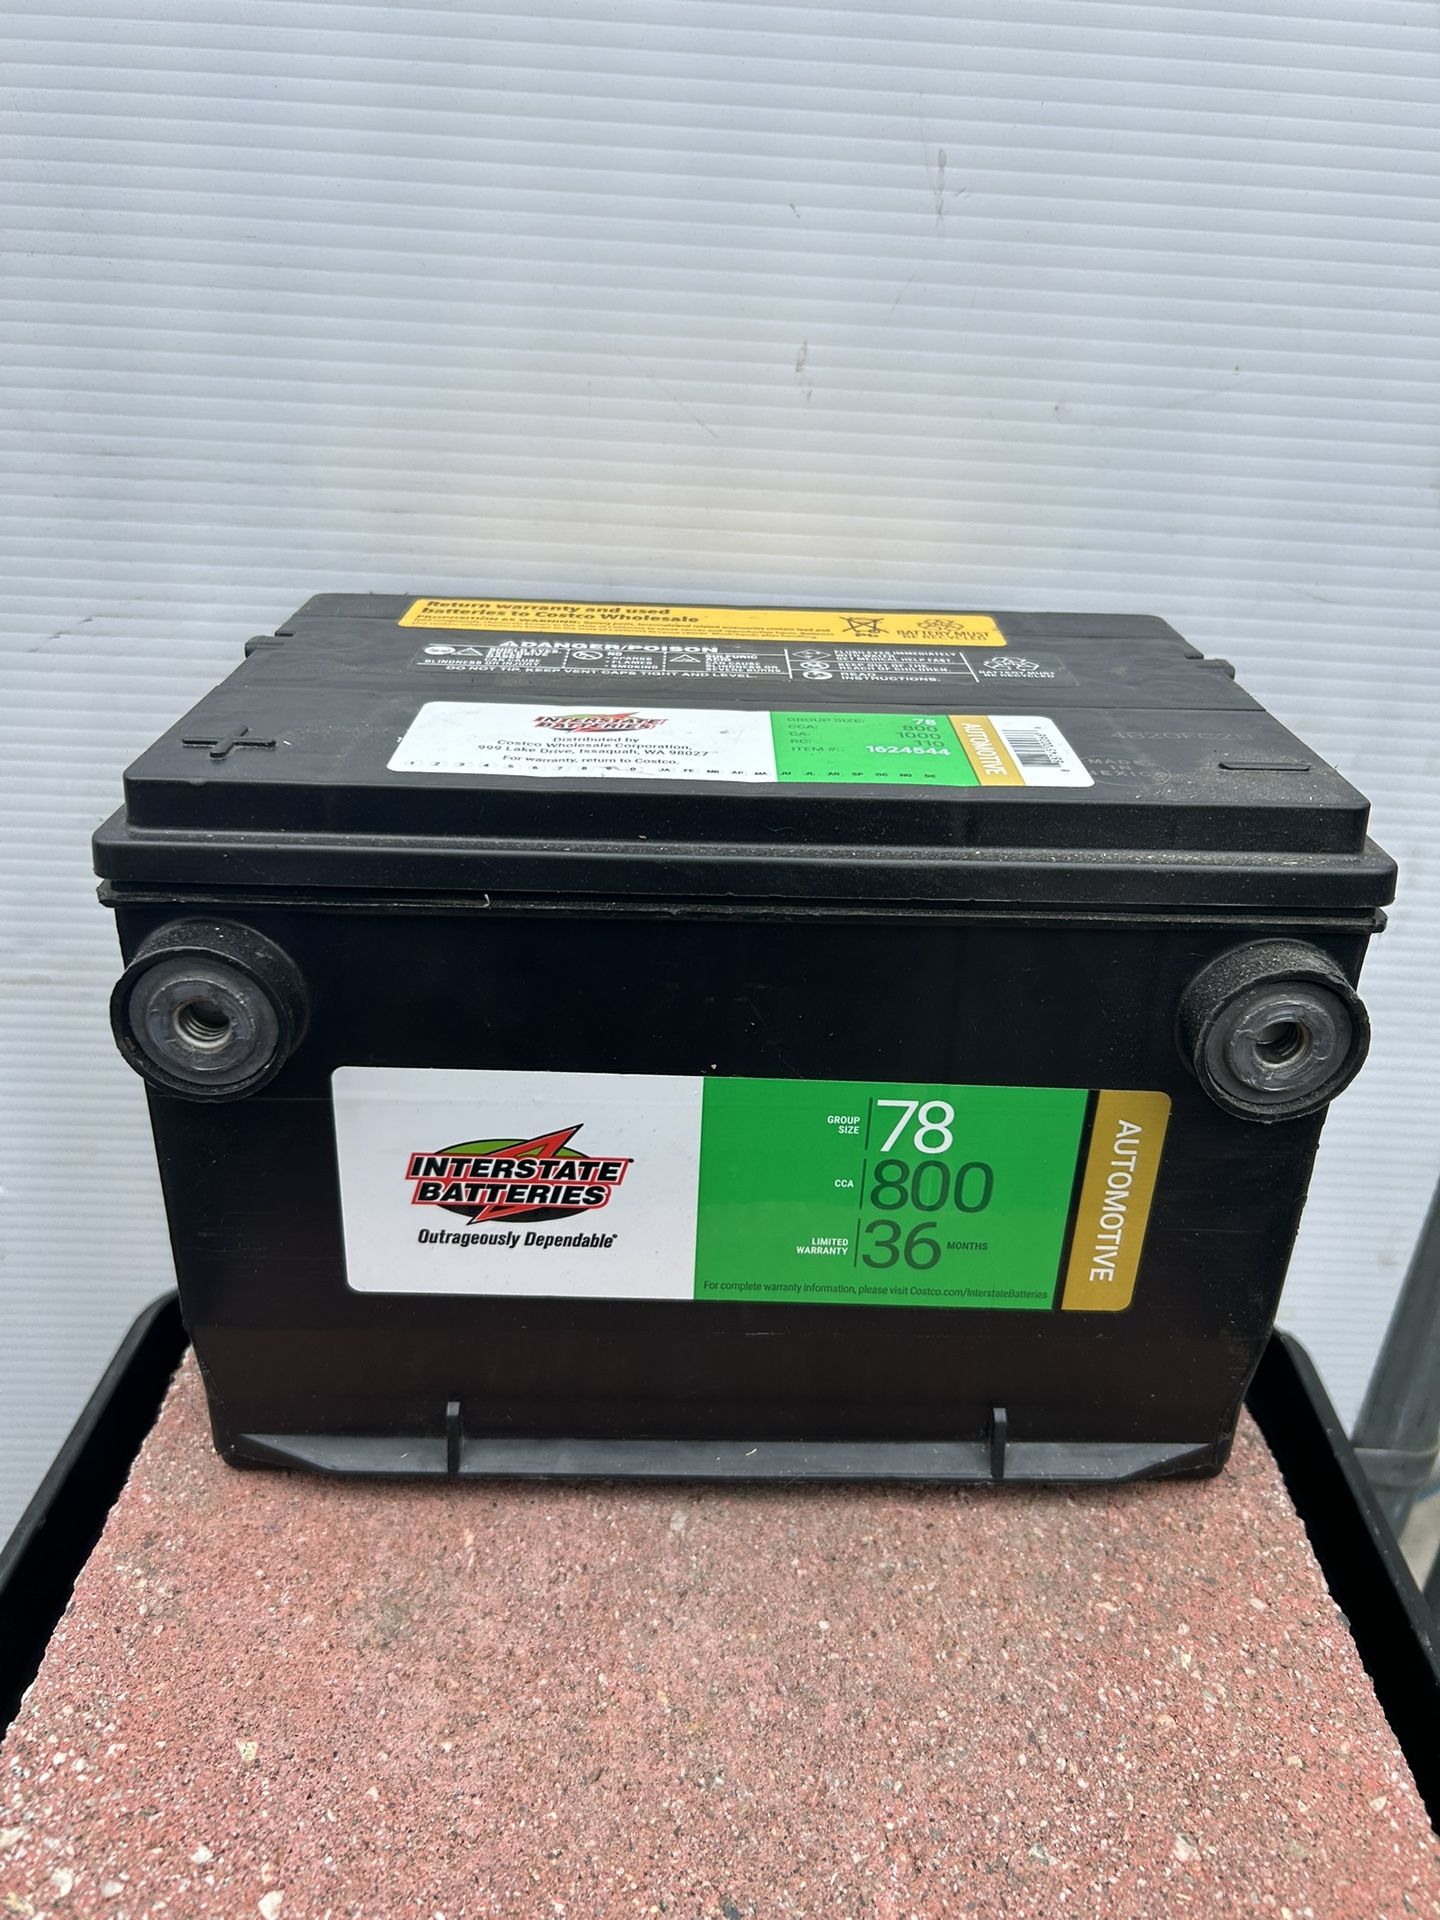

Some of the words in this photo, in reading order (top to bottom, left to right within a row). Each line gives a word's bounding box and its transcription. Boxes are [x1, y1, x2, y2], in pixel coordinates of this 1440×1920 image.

[496, 604, 580, 612] warranty
[421, 607, 506, 616] batteries
[535, 611, 595, 620] Costco
[600, 613, 699, 622] Wholesale
[520, 641, 719, 653] DANGER/POISON
[912, 718, 936, 726] 78
[896, 732, 942, 740] 1000
[497, 739, 542, 747] Costco
[615, 743, 692, 751] Corporation,
[865, 745, 951, 756] 1624544
[961, 722, 1009, 775] AUTOMOTIVE
[827, 1115, 861, 1125] GROUP
[838, 1125, 860, 1134] SIZE
[877, 1099, 955, 1154] 78
[411, 1156, 622, 1182] INTERSTATE
[834, 1178, 854, 1188] CCA
[870, 1159, 994, 1213] 800
[417, 1182, 606, 1206] BATTERIES
[1089, 1119, 1142, 1281] AUTOMOTIVE
[417, 1228, 520, 1249] Outrageously
[811, 1237, 849, 1247] LIMITED
[862, 1219, 942, 1270] 36
[796, 1245, 848, 1256] WARRANTY
[946, 1241, 988, 1250] MONTHS
[703, 1280, 719, 1290] For
[720, 1281, 762, 1292] complete
[764, 1283, 801, 1294] warranty
[803, 1282, 857, 1295] information,
[858, 1284, 888, 1296] please
[889, 1285, 908, 1296] visit
[910, 1286, 1048, 1299] Costco.com/InterstateBatteries
